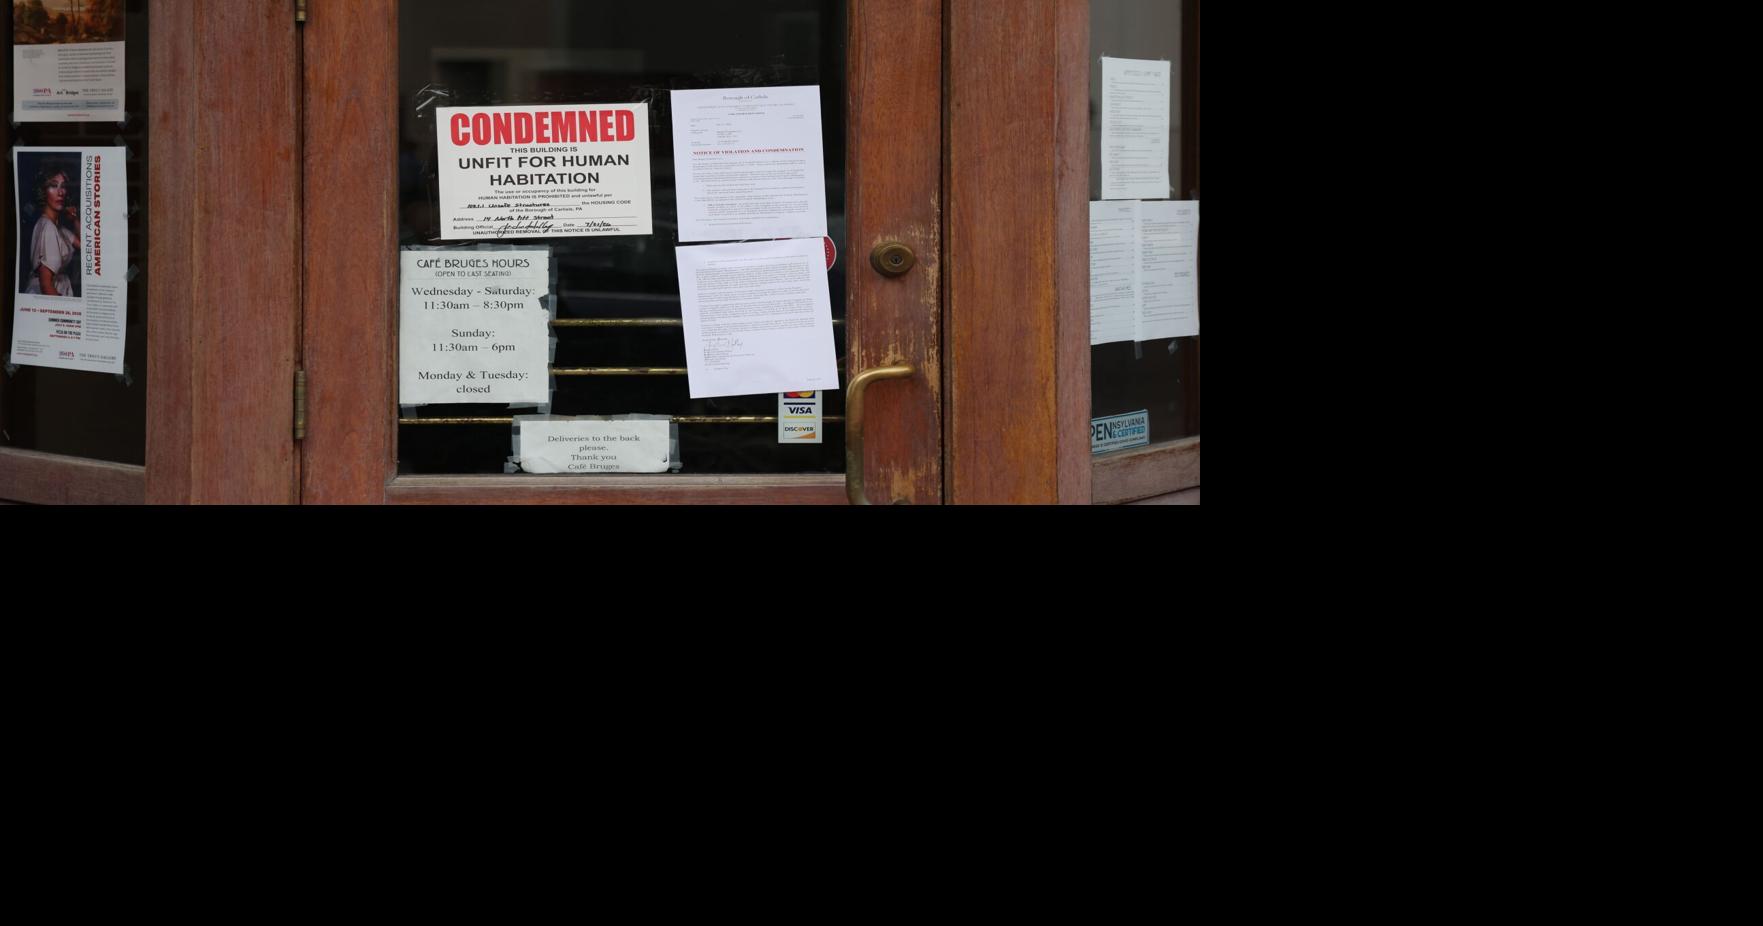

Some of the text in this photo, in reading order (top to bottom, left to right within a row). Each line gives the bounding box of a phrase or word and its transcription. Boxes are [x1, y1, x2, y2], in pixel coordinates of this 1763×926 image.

[450, 110, 636, 146] CONDEMNED
[458, 154, 630, 169] UNFIT FOR HUMAN
[490, 172, 600, 186] HABITATION
[416, 257, 529, 268] CAFÉ BRUGES HOURS
[411, 287, 473, 299] Wednesday
[484, 287, 535, 298] Saturday:
[424, 301, 470, 310] 11:30am
[483, 301, 524, 312] 8:30pm
[451, 329, 495, 339] Sunday:
[432, 343, 478, 351] 11:30am
[492, 343, 515, 353] 6pm
[418, 370, 462, 381] Monday
[480, 370, 528, 381] Tuesday:
[456, 385, 490, 393] closed
